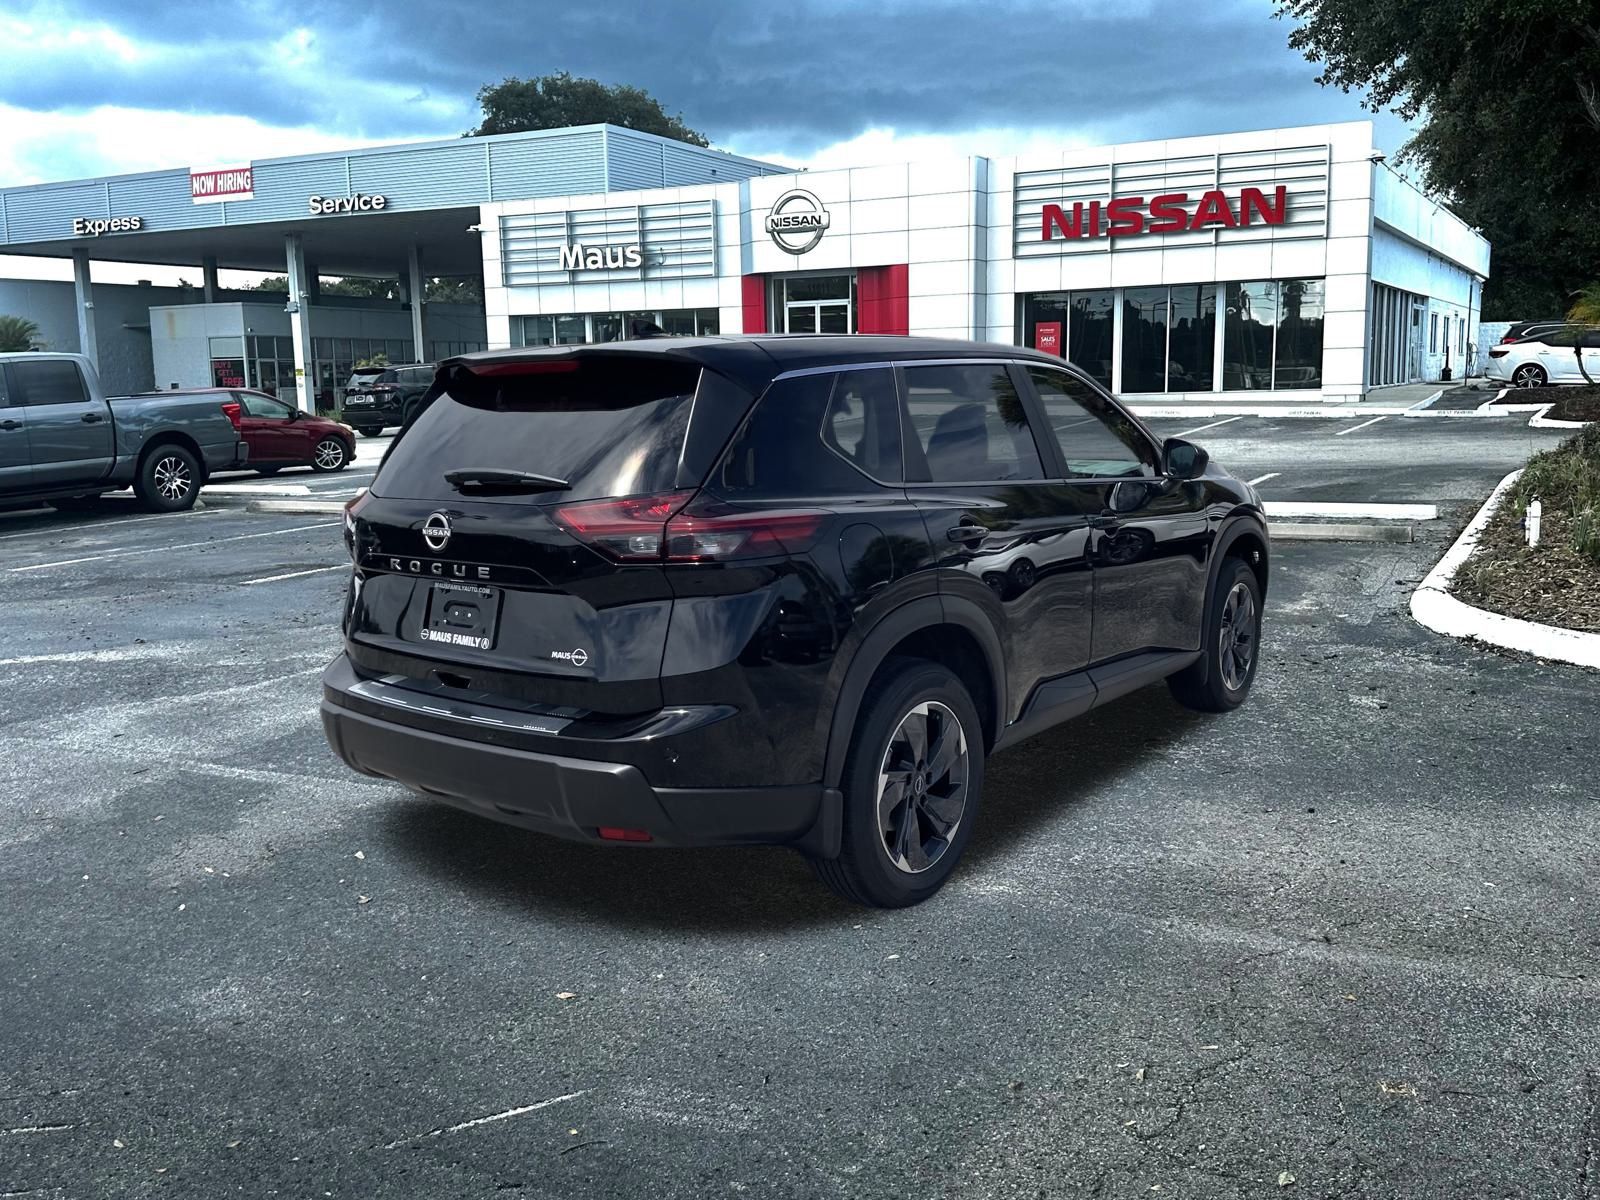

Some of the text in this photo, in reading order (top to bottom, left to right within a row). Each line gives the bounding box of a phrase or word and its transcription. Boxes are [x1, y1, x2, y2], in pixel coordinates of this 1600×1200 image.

[192, 171, 251, 195] NOW HIRING
[308, 193, 385, 215] Service
[1042, 185, 1287, 241] NISSAN
[73, 216, 140, 237] Express
[770, 214, 822, 229] NISSAN
[559, 243, 642, 270] Maus
[223, 377, 244, 386] FREE
[422, 528, 451, 537] NISSAN
[389, 558, 490, 579] ROGUE
[429, 630, 482, 647] MAUS FAMILY
[551, 651, 571, 660] MAUS
